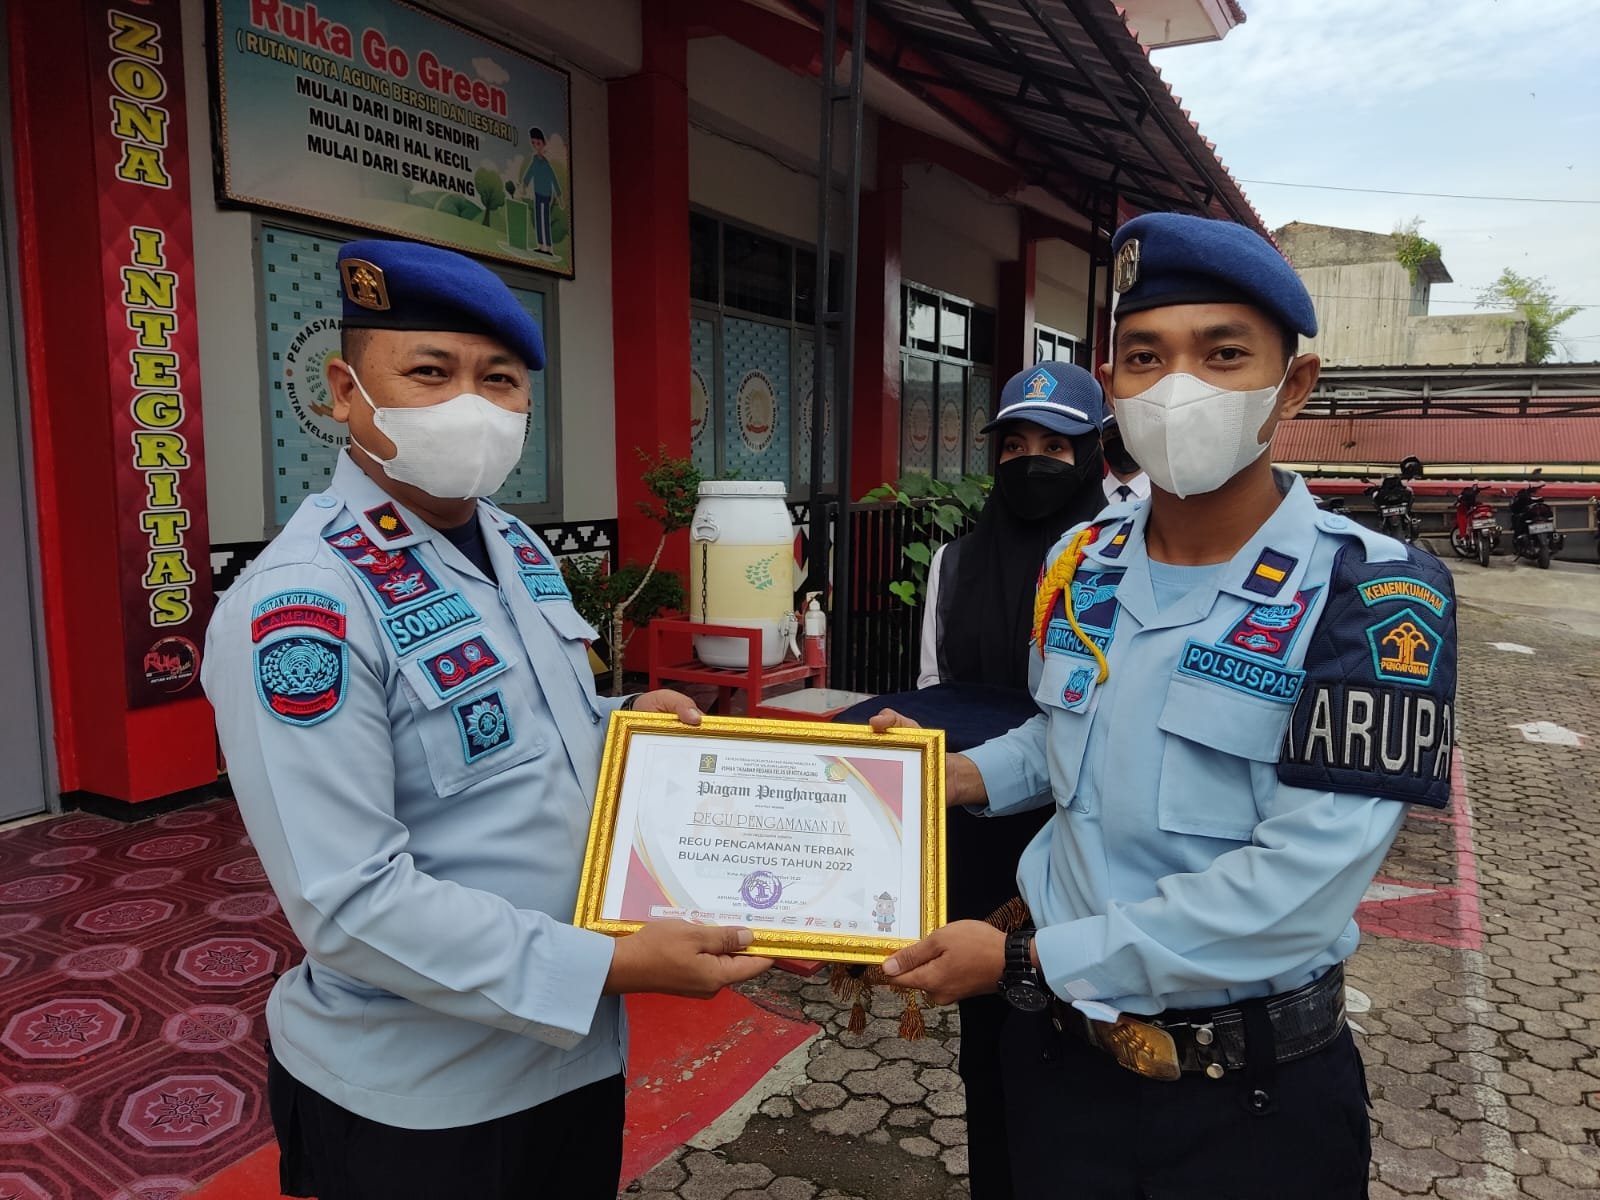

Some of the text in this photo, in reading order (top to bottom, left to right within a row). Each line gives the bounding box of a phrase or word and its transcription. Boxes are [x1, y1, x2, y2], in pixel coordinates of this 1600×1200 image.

[250, 0, 508, 117] Ruka Go Green
[108, 10, 171, 189] ZONA
[246, 31, 298, 67] RUTAN
[302, 51, 340, 82] KOTA
[342, 66, 390, 98] AGUNG
[391, 82, 439, 116] BERSIH
[441, 104, 466, 125] DAN
[468, 111, 512, 141] LESTARI
[297, 76, 479, 151] MULAI DARI DIRI SENDIRI
[309, 107, 472, 172] MULAI DARI HAL KECIL
[307, 134, 475, 197] MULAI DARI SEKARANG
[121, 226, 195, 626] INTEGRITAS
[286, 382, 306, 421] RUTAN
[304, 420, 334, 443] KELAS
[261, 595, 338, 613] RUTAN KOTA AGUNG
[261, 610, 338, 628] LAMPUNG
[391, 595, 473, 644] SOBIRIN
[1364, 581, 1442, 610] KEMENKUMHAM
[1187, 648, 1298, 696] POLSUSPAS
[1380, 661, 1428, 676] PENGAYOMAN
[1289, 688, 1450, 780] ARUPA
[696, 781, 847, 804] Piagam Penghargaan
[678, 836, 855, 857] REGU PENGAMANAN TERBAIK
[693, 811, 846, 833] REGU PENGAMANAN IV
[678, 851, 853, 872] BULAN AGUSTUS TAHUN 2022
